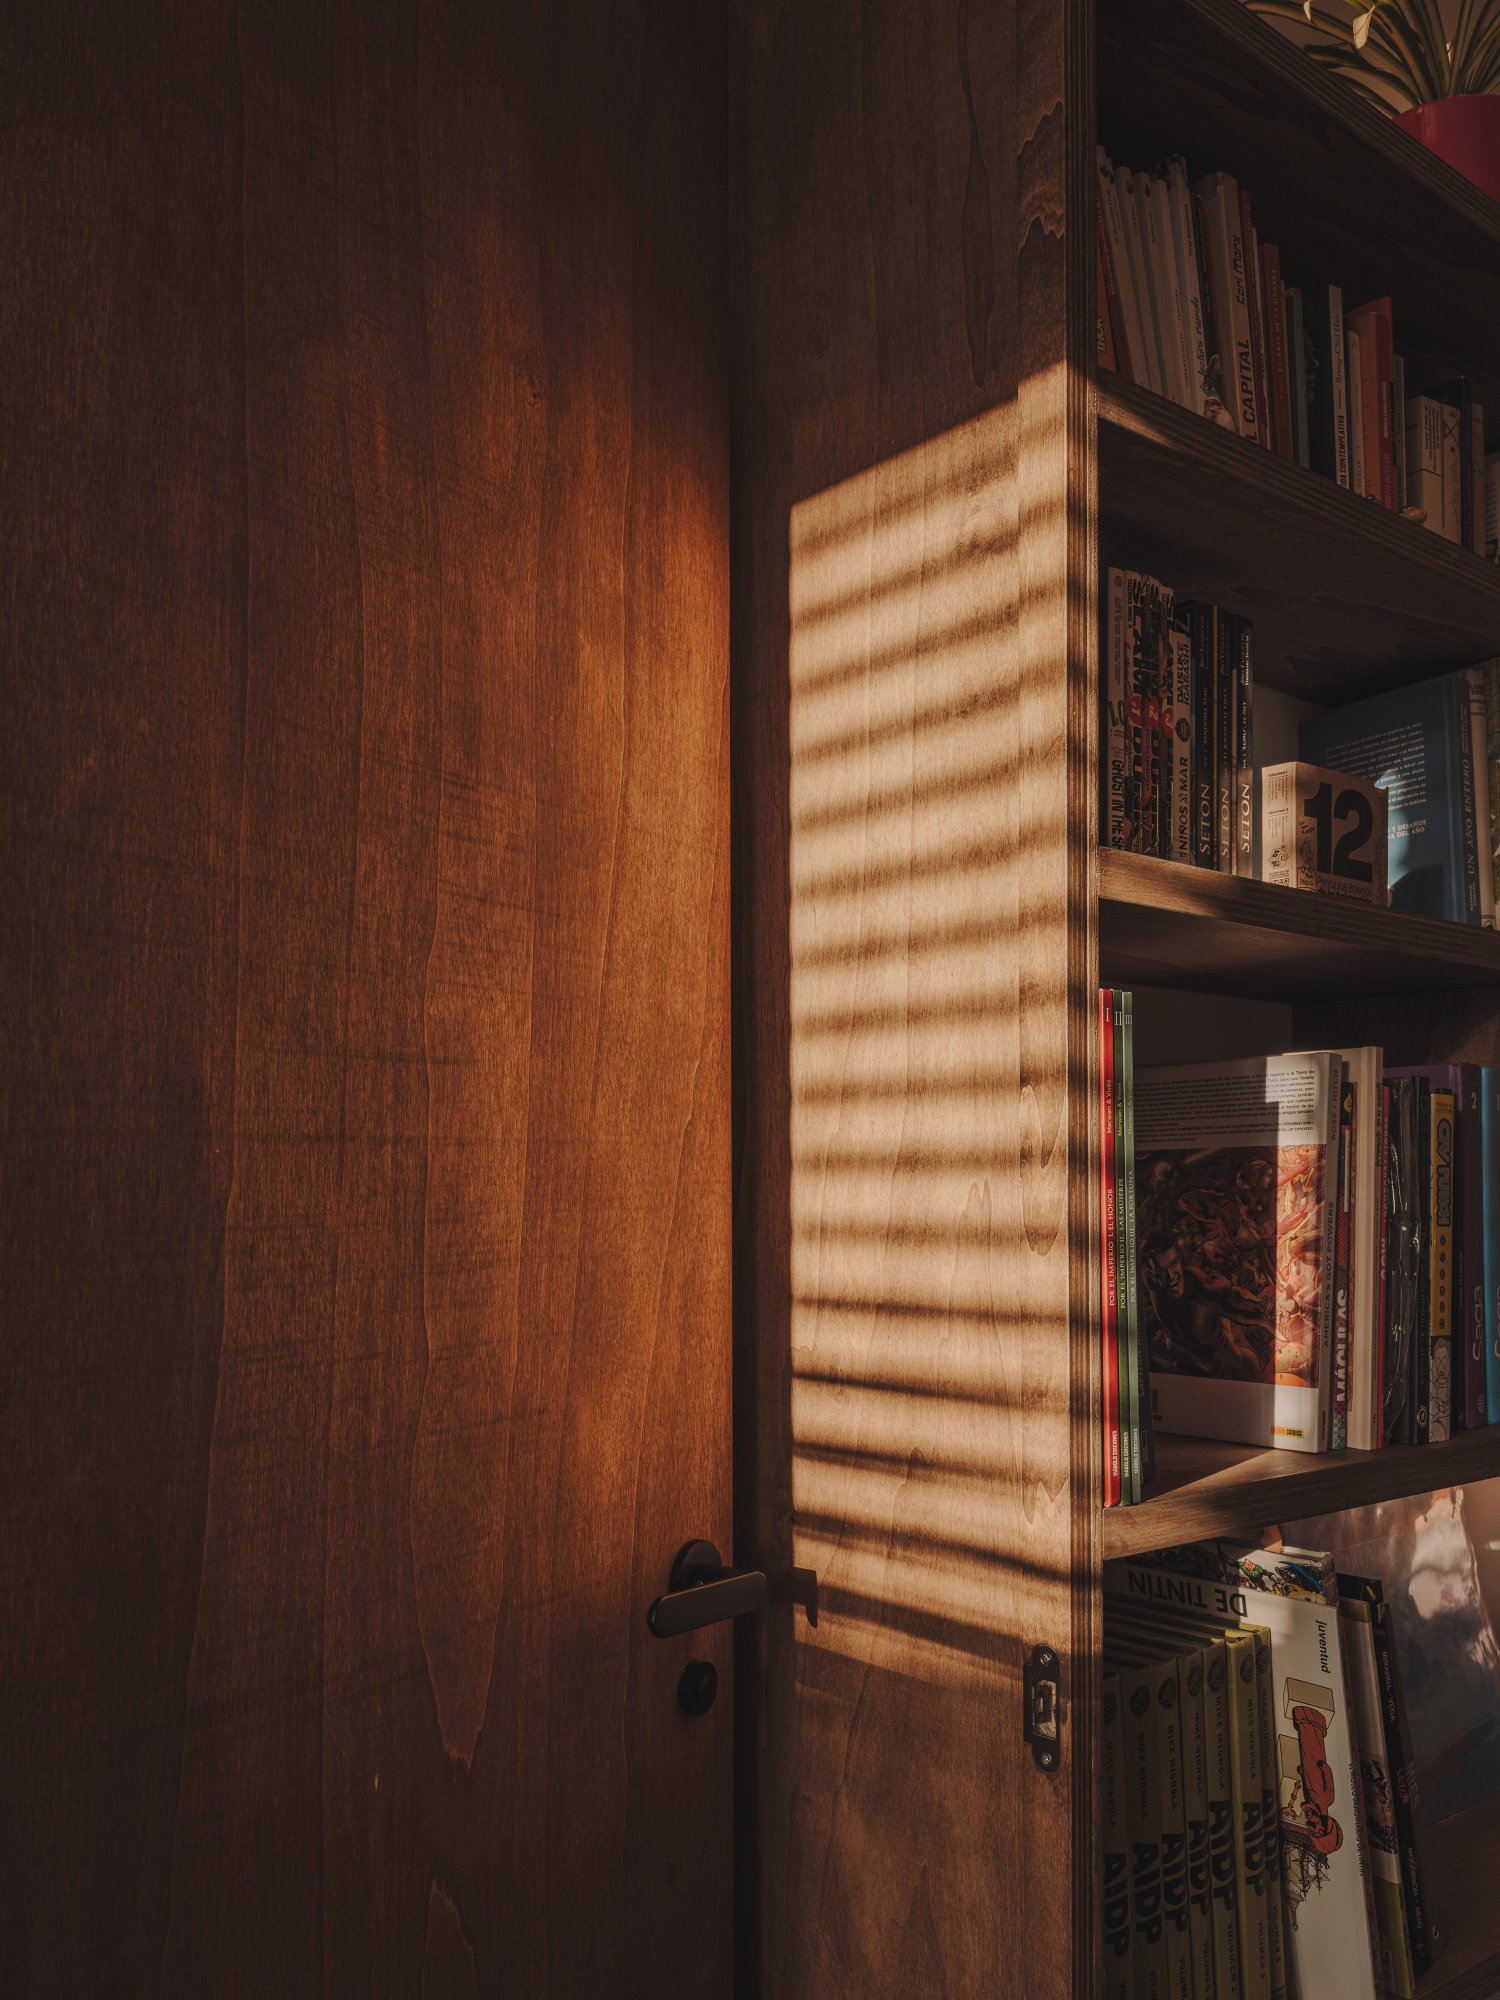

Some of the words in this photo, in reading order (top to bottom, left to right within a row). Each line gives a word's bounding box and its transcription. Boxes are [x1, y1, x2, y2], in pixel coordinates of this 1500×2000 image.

[1233, 234, 1244, 275] Marx
[1238, 339, 1256, 425] CAPITAL
[1338, 415, 1348, 473] CONTEMPLATIVA
[1176, 642, 1185, 704] DAISUKE
[1111, 759, 1124, 799] GHOST
[1179, 756, 1189, 792] MAR
[1462, 759, 1473, 814] ENTERO
[1111, 799, 1124, 812] IN
[1111, 813, 1124, 836] THE
[1179, 805, 1188, 850] NIÑOS
[1200, 784, 1210, 856] SETON
[1220, 788, 1231, 859] SETON
[1240, 783, 1250, 853] SETON
[1397, 820, 1427, 831] DESAFÍOS
[1304, 781, 1374, 883] 12
[1397, 829, 1409, 838] DEL
[1411, 826, 1425, 835] AÑO
[1464, 818, 1474, 849] AÑO
[1466, 854, 1475, 875] UN
[1114, 1011, 1122, 1026] II
[1471, 1090, 1478, 1110] 2
[1109, 1276, 1115, 1287] EL
[1120, 1280, 1125, 1290] EL
[1323, 1283, 1331, 1348] AMERICA'S
[1127, 1569, 1208, 1609] TINTÍN
[1215, 1588, 1248, 1617] DE
[1315, 1620, 1332, 1674] juventud
[1215, 1696, 1224, 1730] MIKE
[1247, 1698, 1255, 1730] MIKE
[1388, 1698, 1396, 1723] VEGA
[1167, 1724, 1176, 1756] MIKE
[1217, 1732, 1225, 1792] MIGNOLA
[1248, 1731, 1256, 1781] MIGNOLA
[1169, 1758, 1178, 1811] MIGNOLA
[1404, 1760, 1422, 1811] MIES
[1188, 1819, 1210, 1916] AIDP
[1208, 1800, 1235, 1911] AIDP
[1242, 1801, 1265, 1897] AIDP
[1103, 1853, 1130, 1957] AIDP
[1132, 1842, 1163, 1944] AIDP
[1160, 1833, 1188, 1932] AIDP
[1227, 1921, 1237, 1982] VOLUMEN
[1257, 1919, 1266, 1971] VOLUMEN
[1272, 1903, 1281, 1953] VOLUMEN
